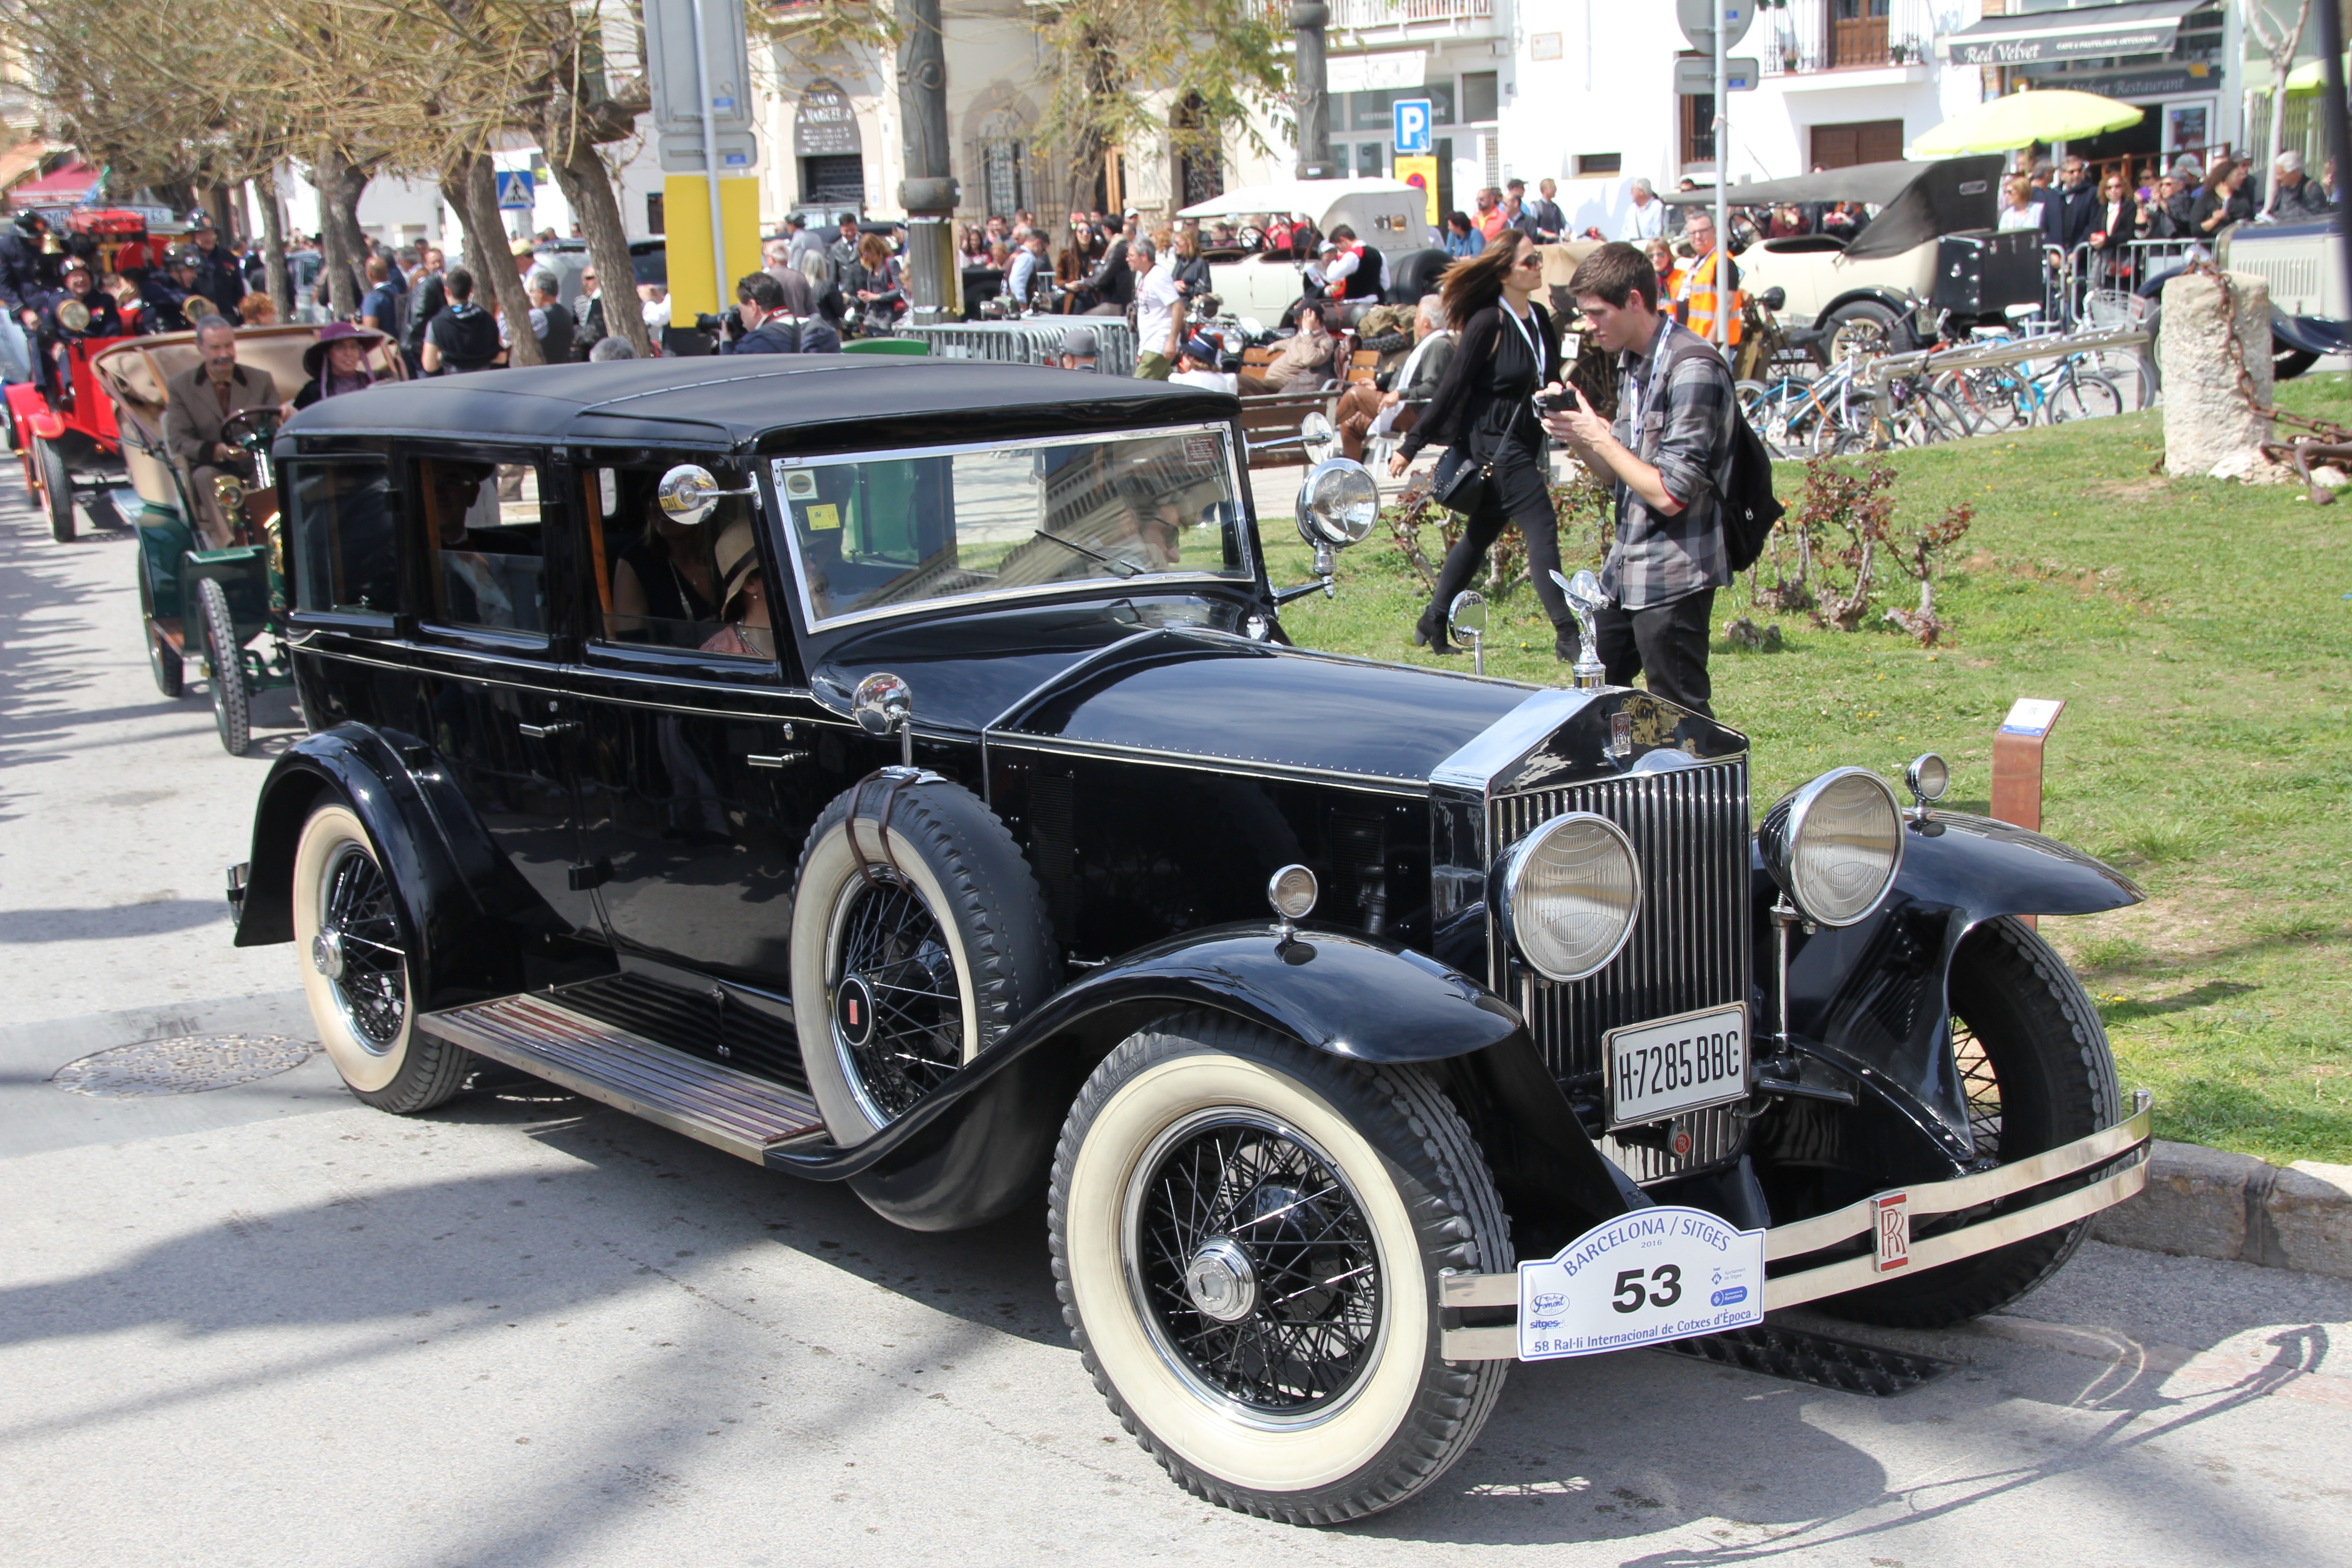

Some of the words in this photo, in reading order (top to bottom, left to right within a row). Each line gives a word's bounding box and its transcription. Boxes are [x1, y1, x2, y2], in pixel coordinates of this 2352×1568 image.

[1964, 41, 1997, 64] Red
[1998, 39, 2041, 61] Velvet
[2113, 77, 2185, 95] Restaurant
[1401, 107, 1425, 146] P
[1088, 1055, 1140, 1112] DENMAN
[1563, 1218, 1666, 1277] BARCELONA
[1681, 1218, 1731, 1251] SITGES
[1641, 1239, 1662, 1249] 2016
[1724, 1267, 1746, 1275] Ajuntament
[1612, 1264, 1681, 1313] 53
[1534, 1295, 1565, 1313] Foment
[1530, 1319, 1560, 1330] sitges
[1534, 1341, 1549, 1352] 58
[1588, 1325, 1658, 1348] Internacional
[1661, 1323, 1674, 1335] de
[1677, 1318, 1711, 1332] Cotxes
[1714, 1308, 1751, 1326] d'Època
